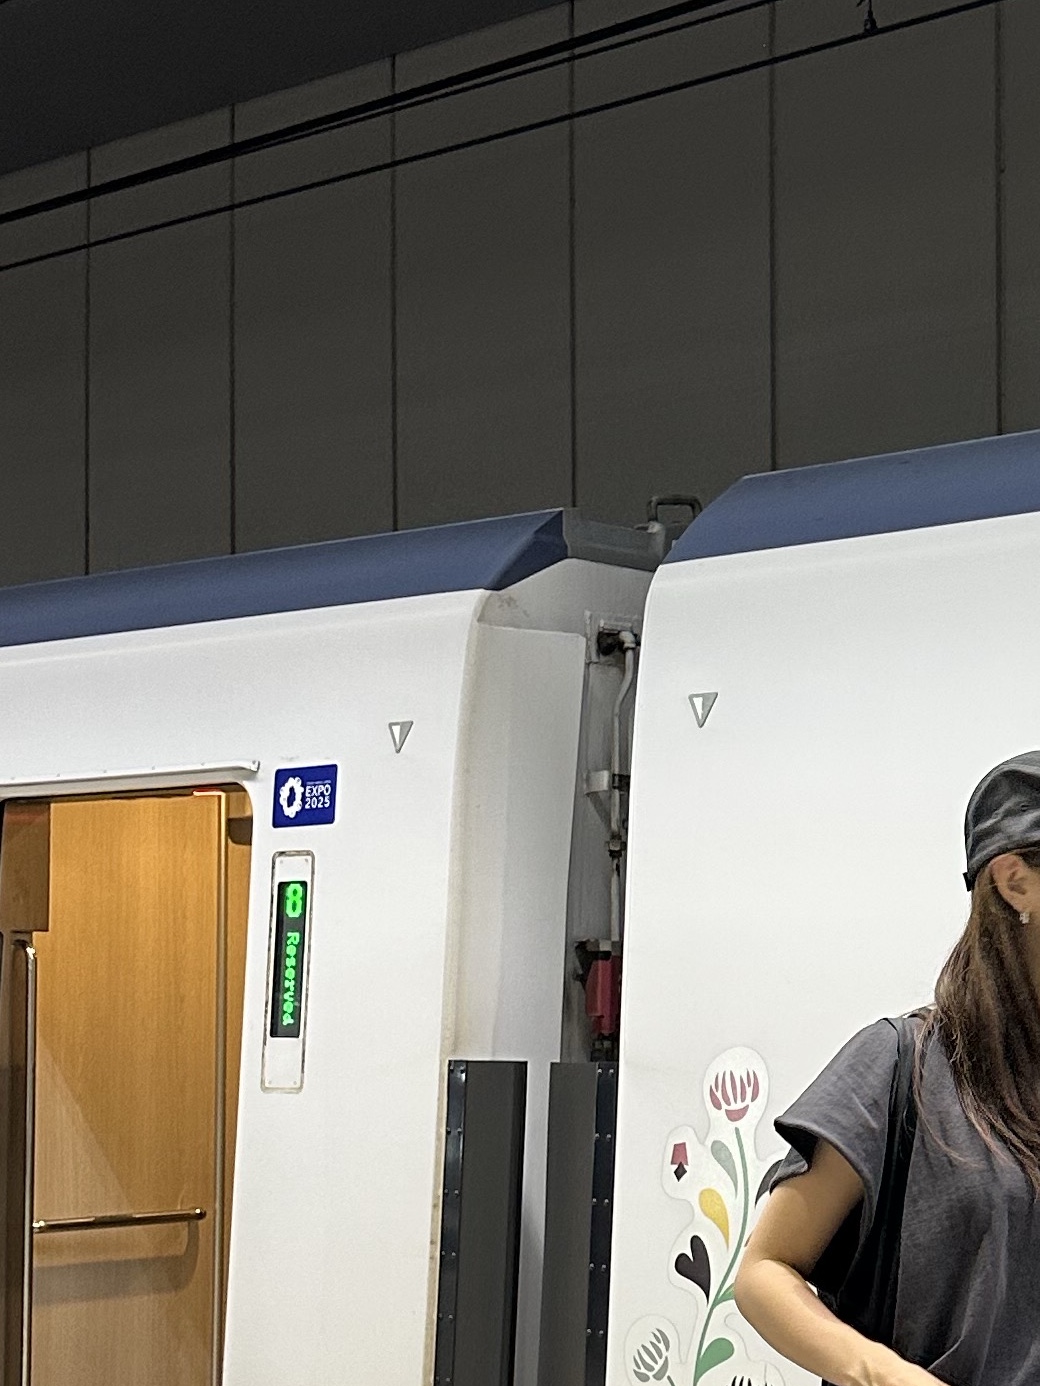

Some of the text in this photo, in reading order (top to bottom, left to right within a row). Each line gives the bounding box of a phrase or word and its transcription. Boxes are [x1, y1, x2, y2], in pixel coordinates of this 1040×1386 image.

[305, 784, 332, 797] EXPO
[304, 796, 331, 809] 2025
[282, 883, 303, 1026] 8 Reserved
